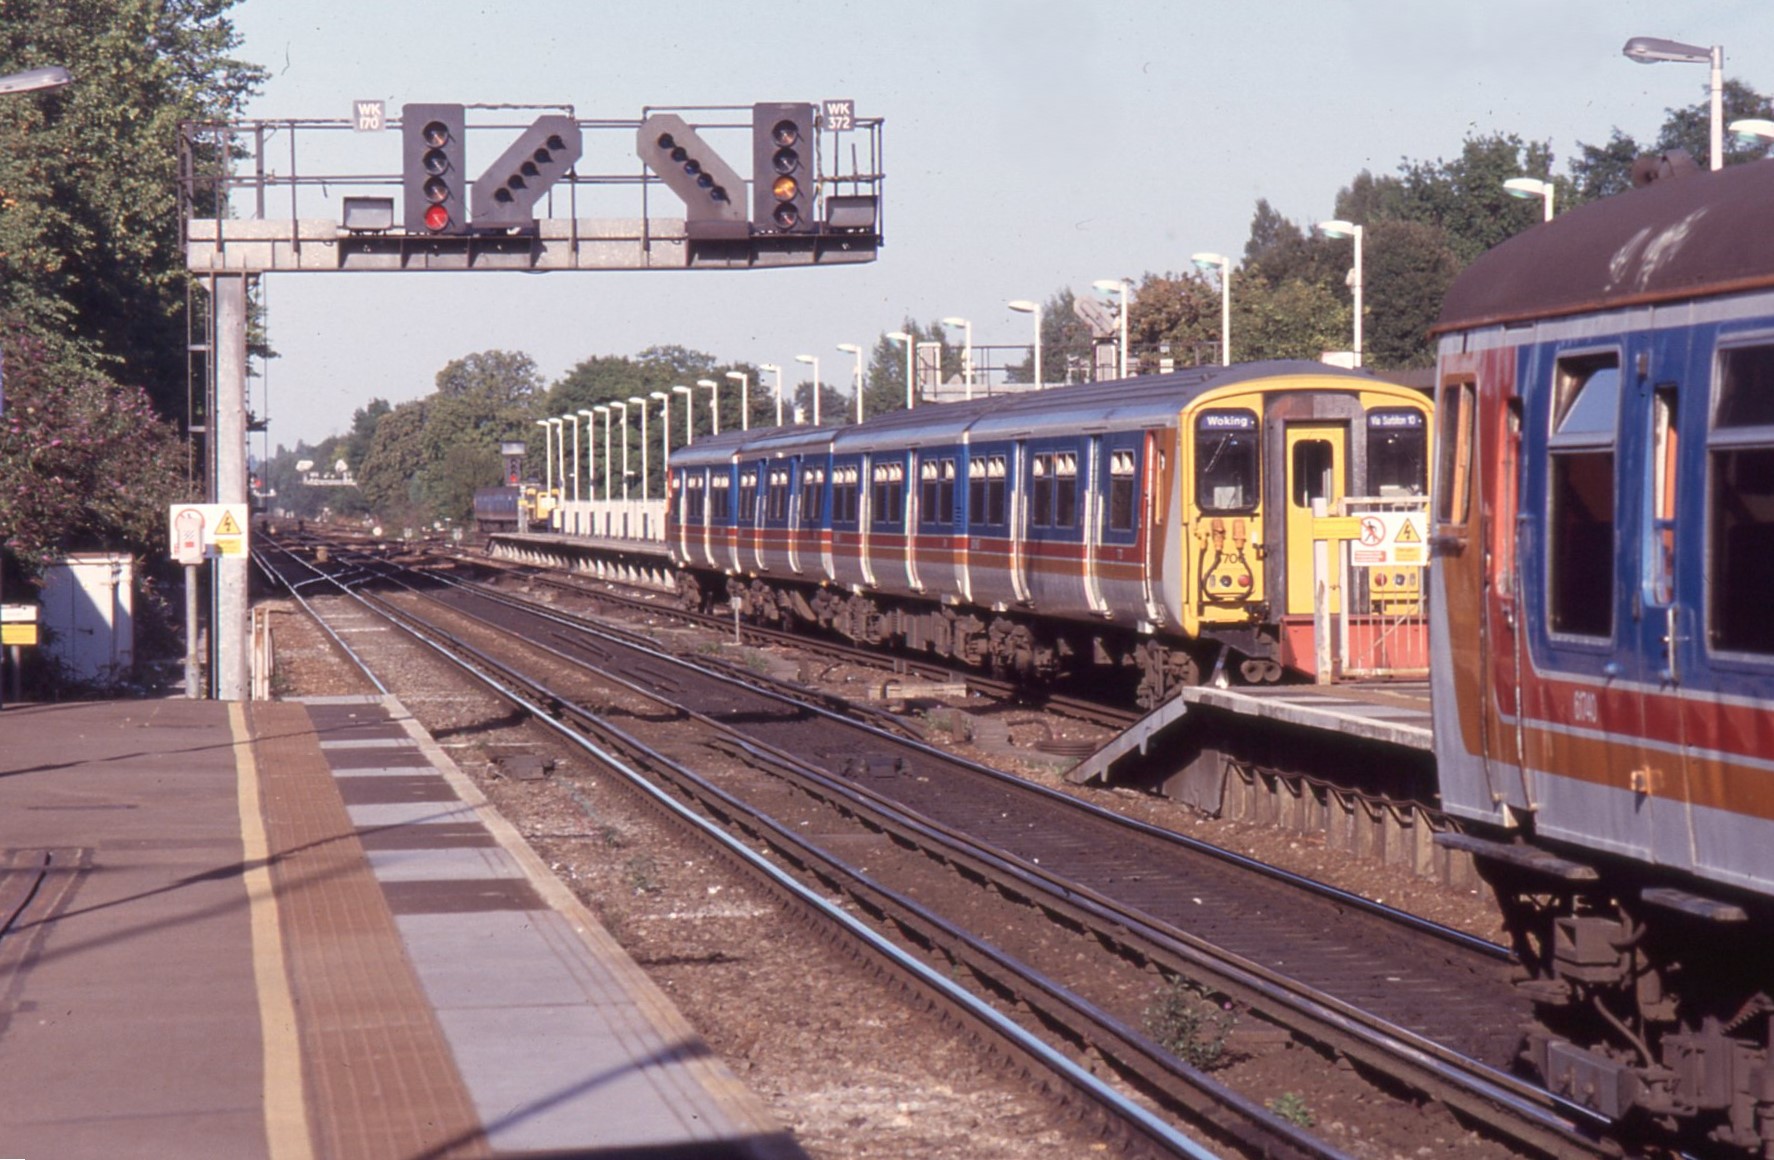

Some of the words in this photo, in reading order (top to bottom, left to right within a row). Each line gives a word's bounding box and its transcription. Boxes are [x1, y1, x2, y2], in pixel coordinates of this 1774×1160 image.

[357, 103, 381, 115] WK
[827, 103, 850, 115] WK
[359, 117, 379, 129] 170
[828, 116, 850, 129] 372
[1207, 416, 1248, 428] Woking
